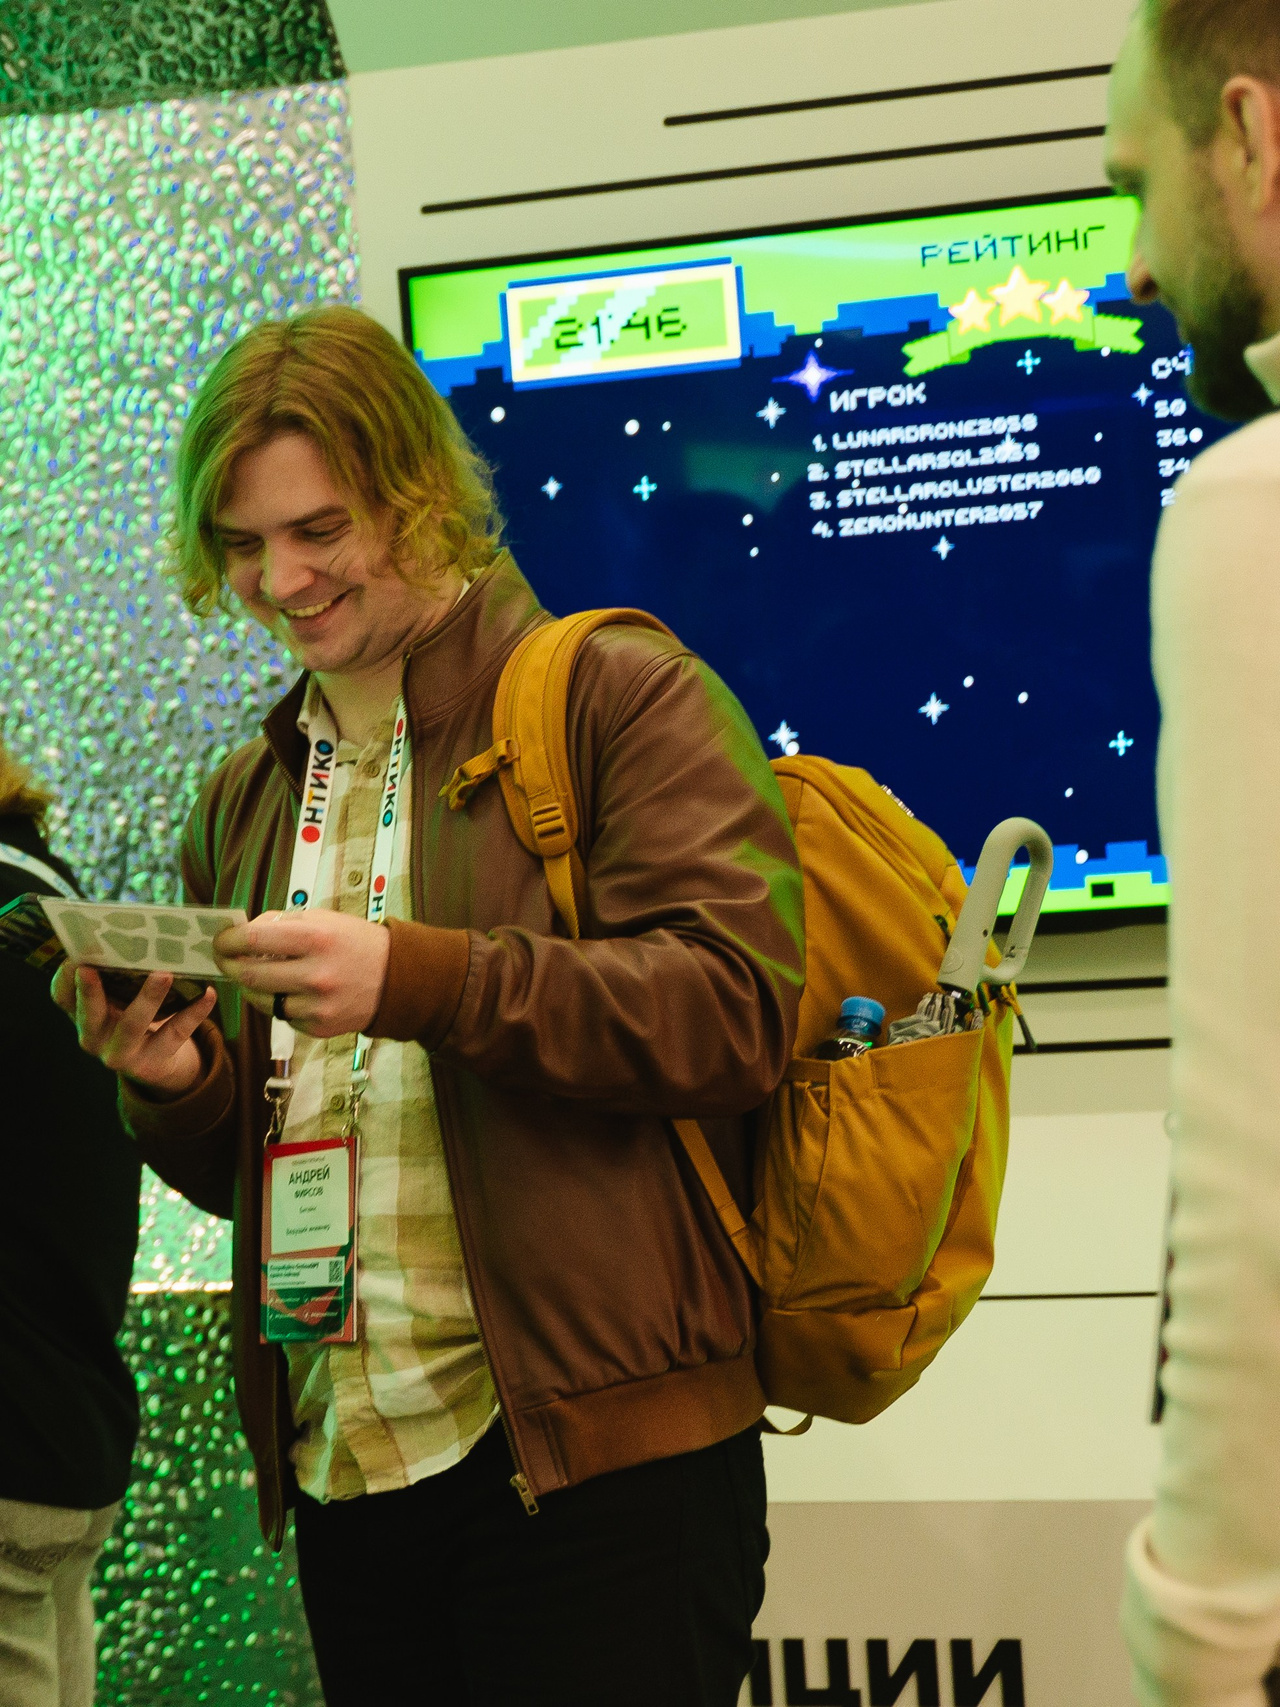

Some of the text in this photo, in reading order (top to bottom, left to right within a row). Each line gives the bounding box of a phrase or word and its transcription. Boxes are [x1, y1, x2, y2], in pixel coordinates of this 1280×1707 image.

[920, 224, 1106, 268] РЕЙТИНГ
[554, 306, 687, 350] 21:46
[829, 381, 927, 413] ИГРОК
[812, 433, 828, 453] 1.
[807, 462, 830, 482] 2.
[809, 490, 832, 510] 3.
[811, 519, 834, 539] 4.
[288, 1164, 330, 1186] АНДРЕЙ
